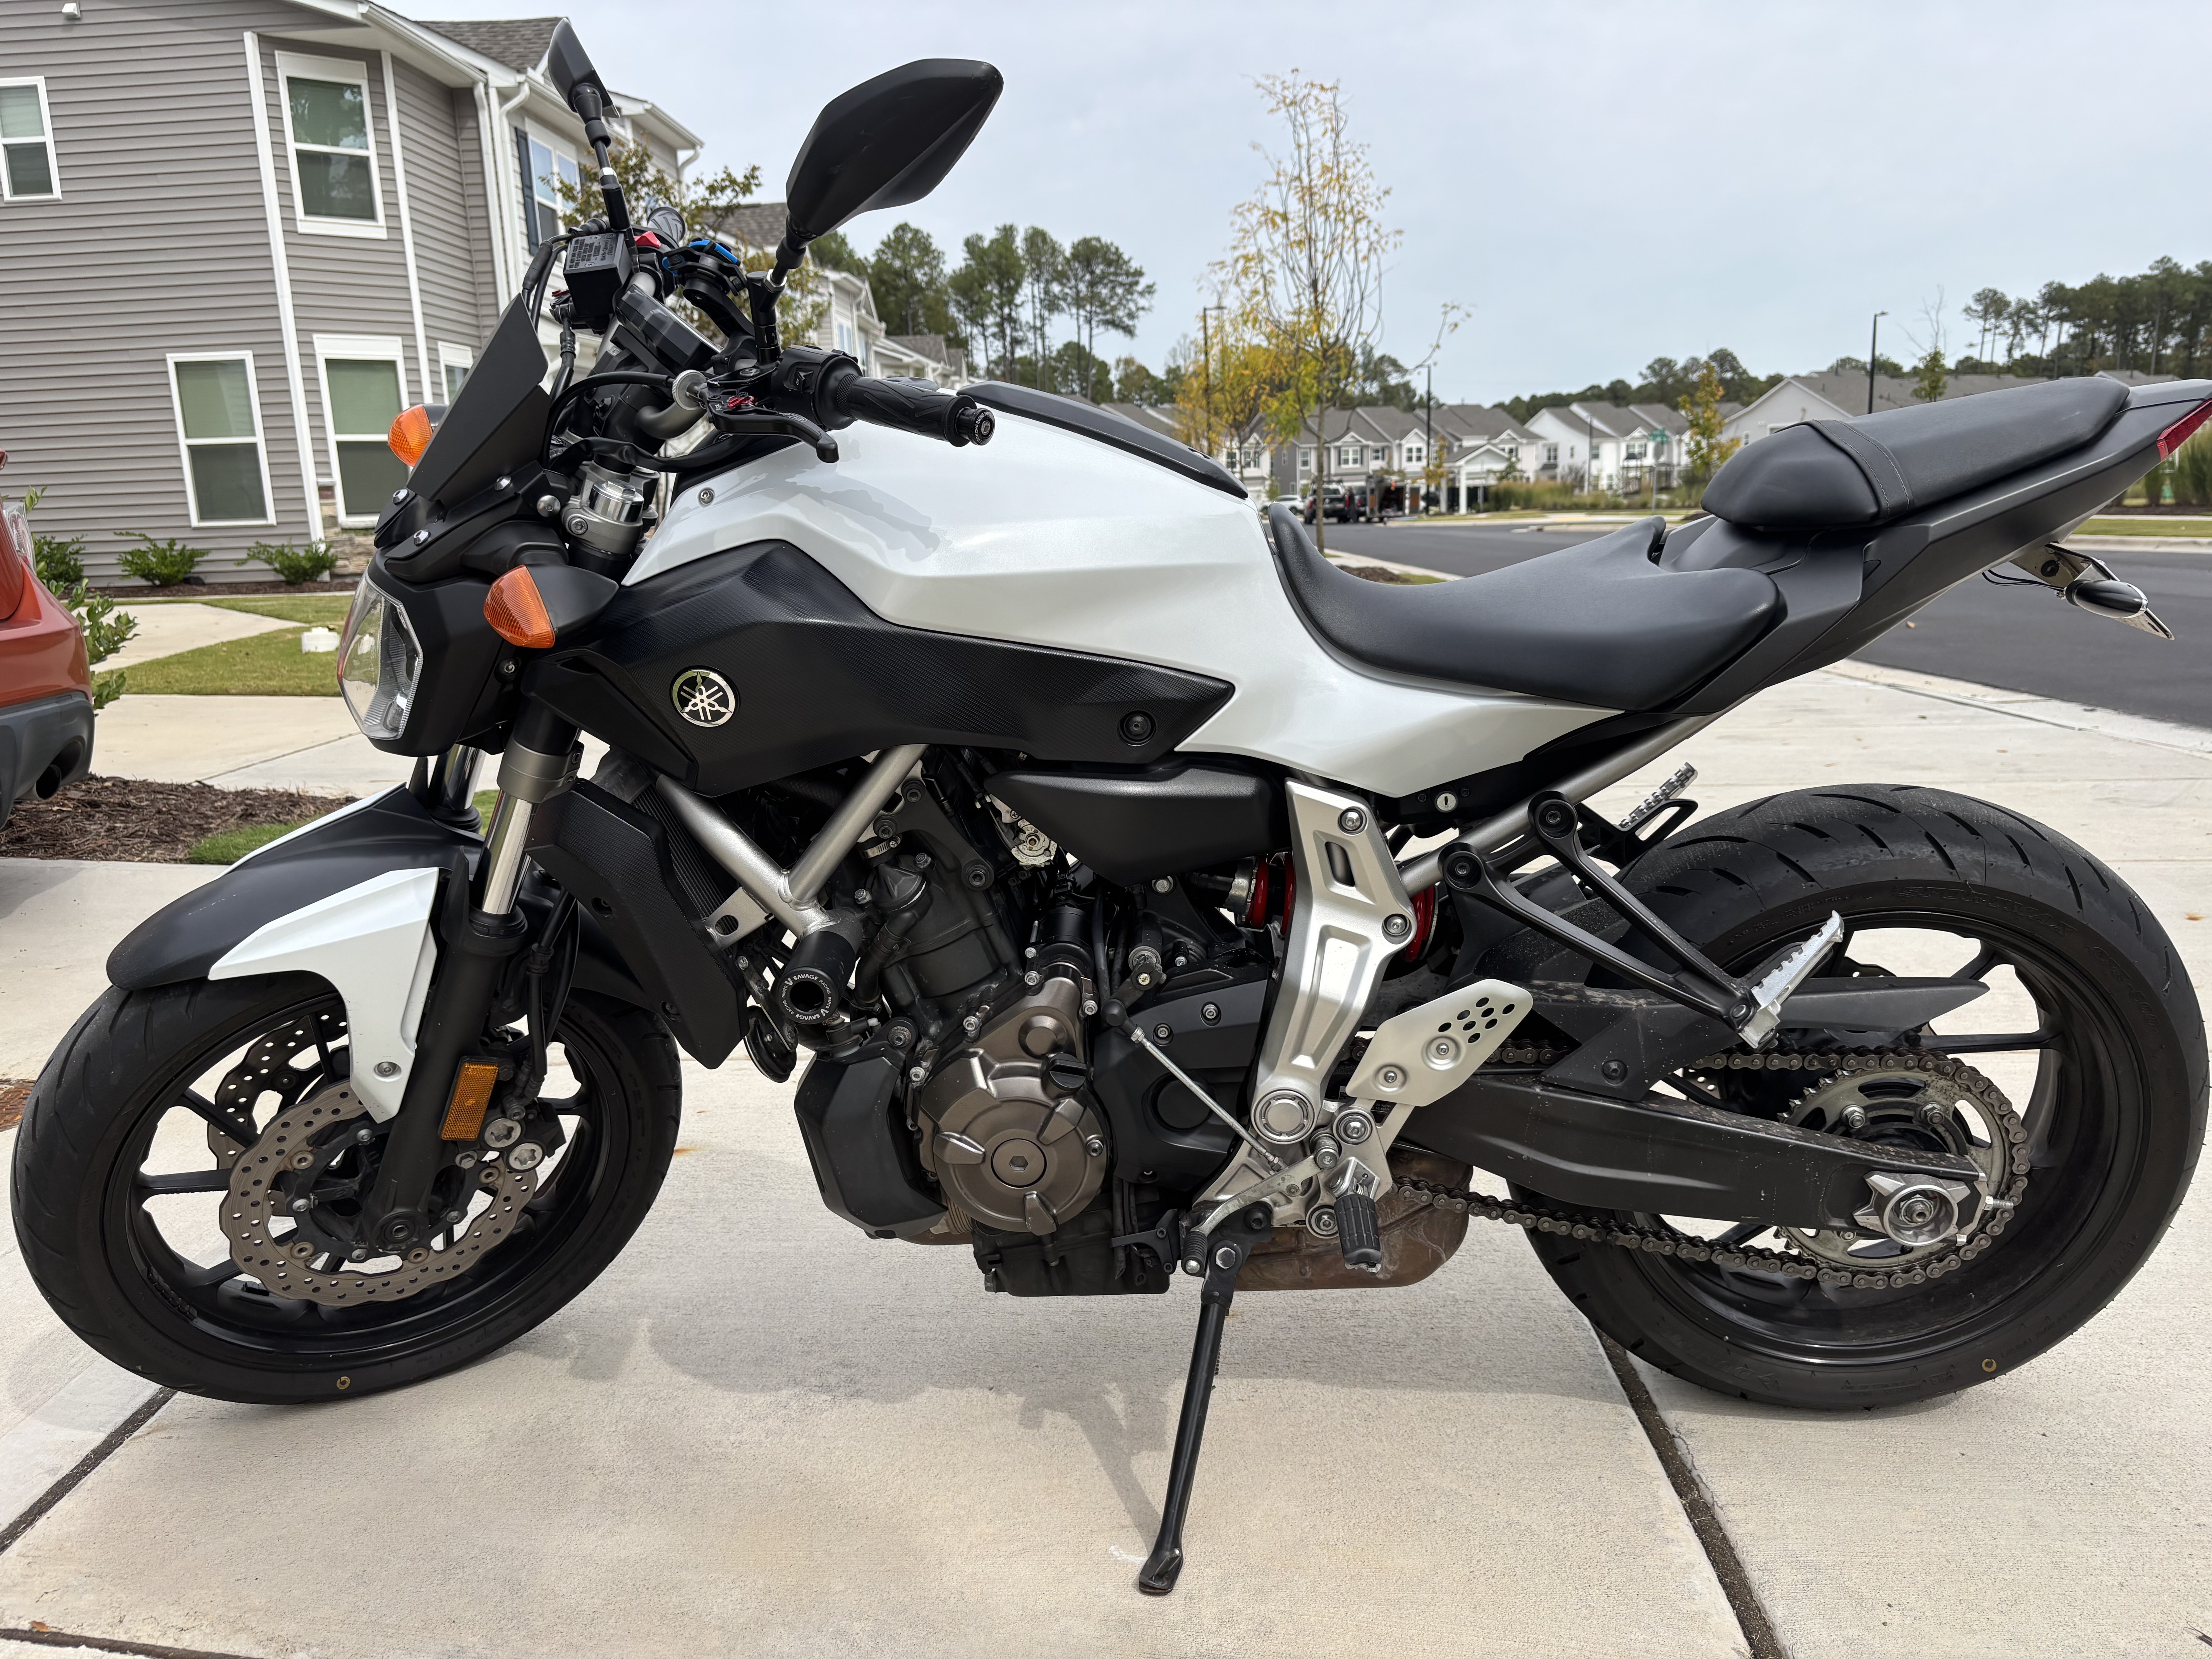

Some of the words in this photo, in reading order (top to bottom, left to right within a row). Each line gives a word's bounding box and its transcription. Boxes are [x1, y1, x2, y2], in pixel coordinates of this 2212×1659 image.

[1895, 886, 2078, 936] SPORTMAX
[819, 979, 831, 994] RACING
[783, 1000, 794, 1015] RACING
